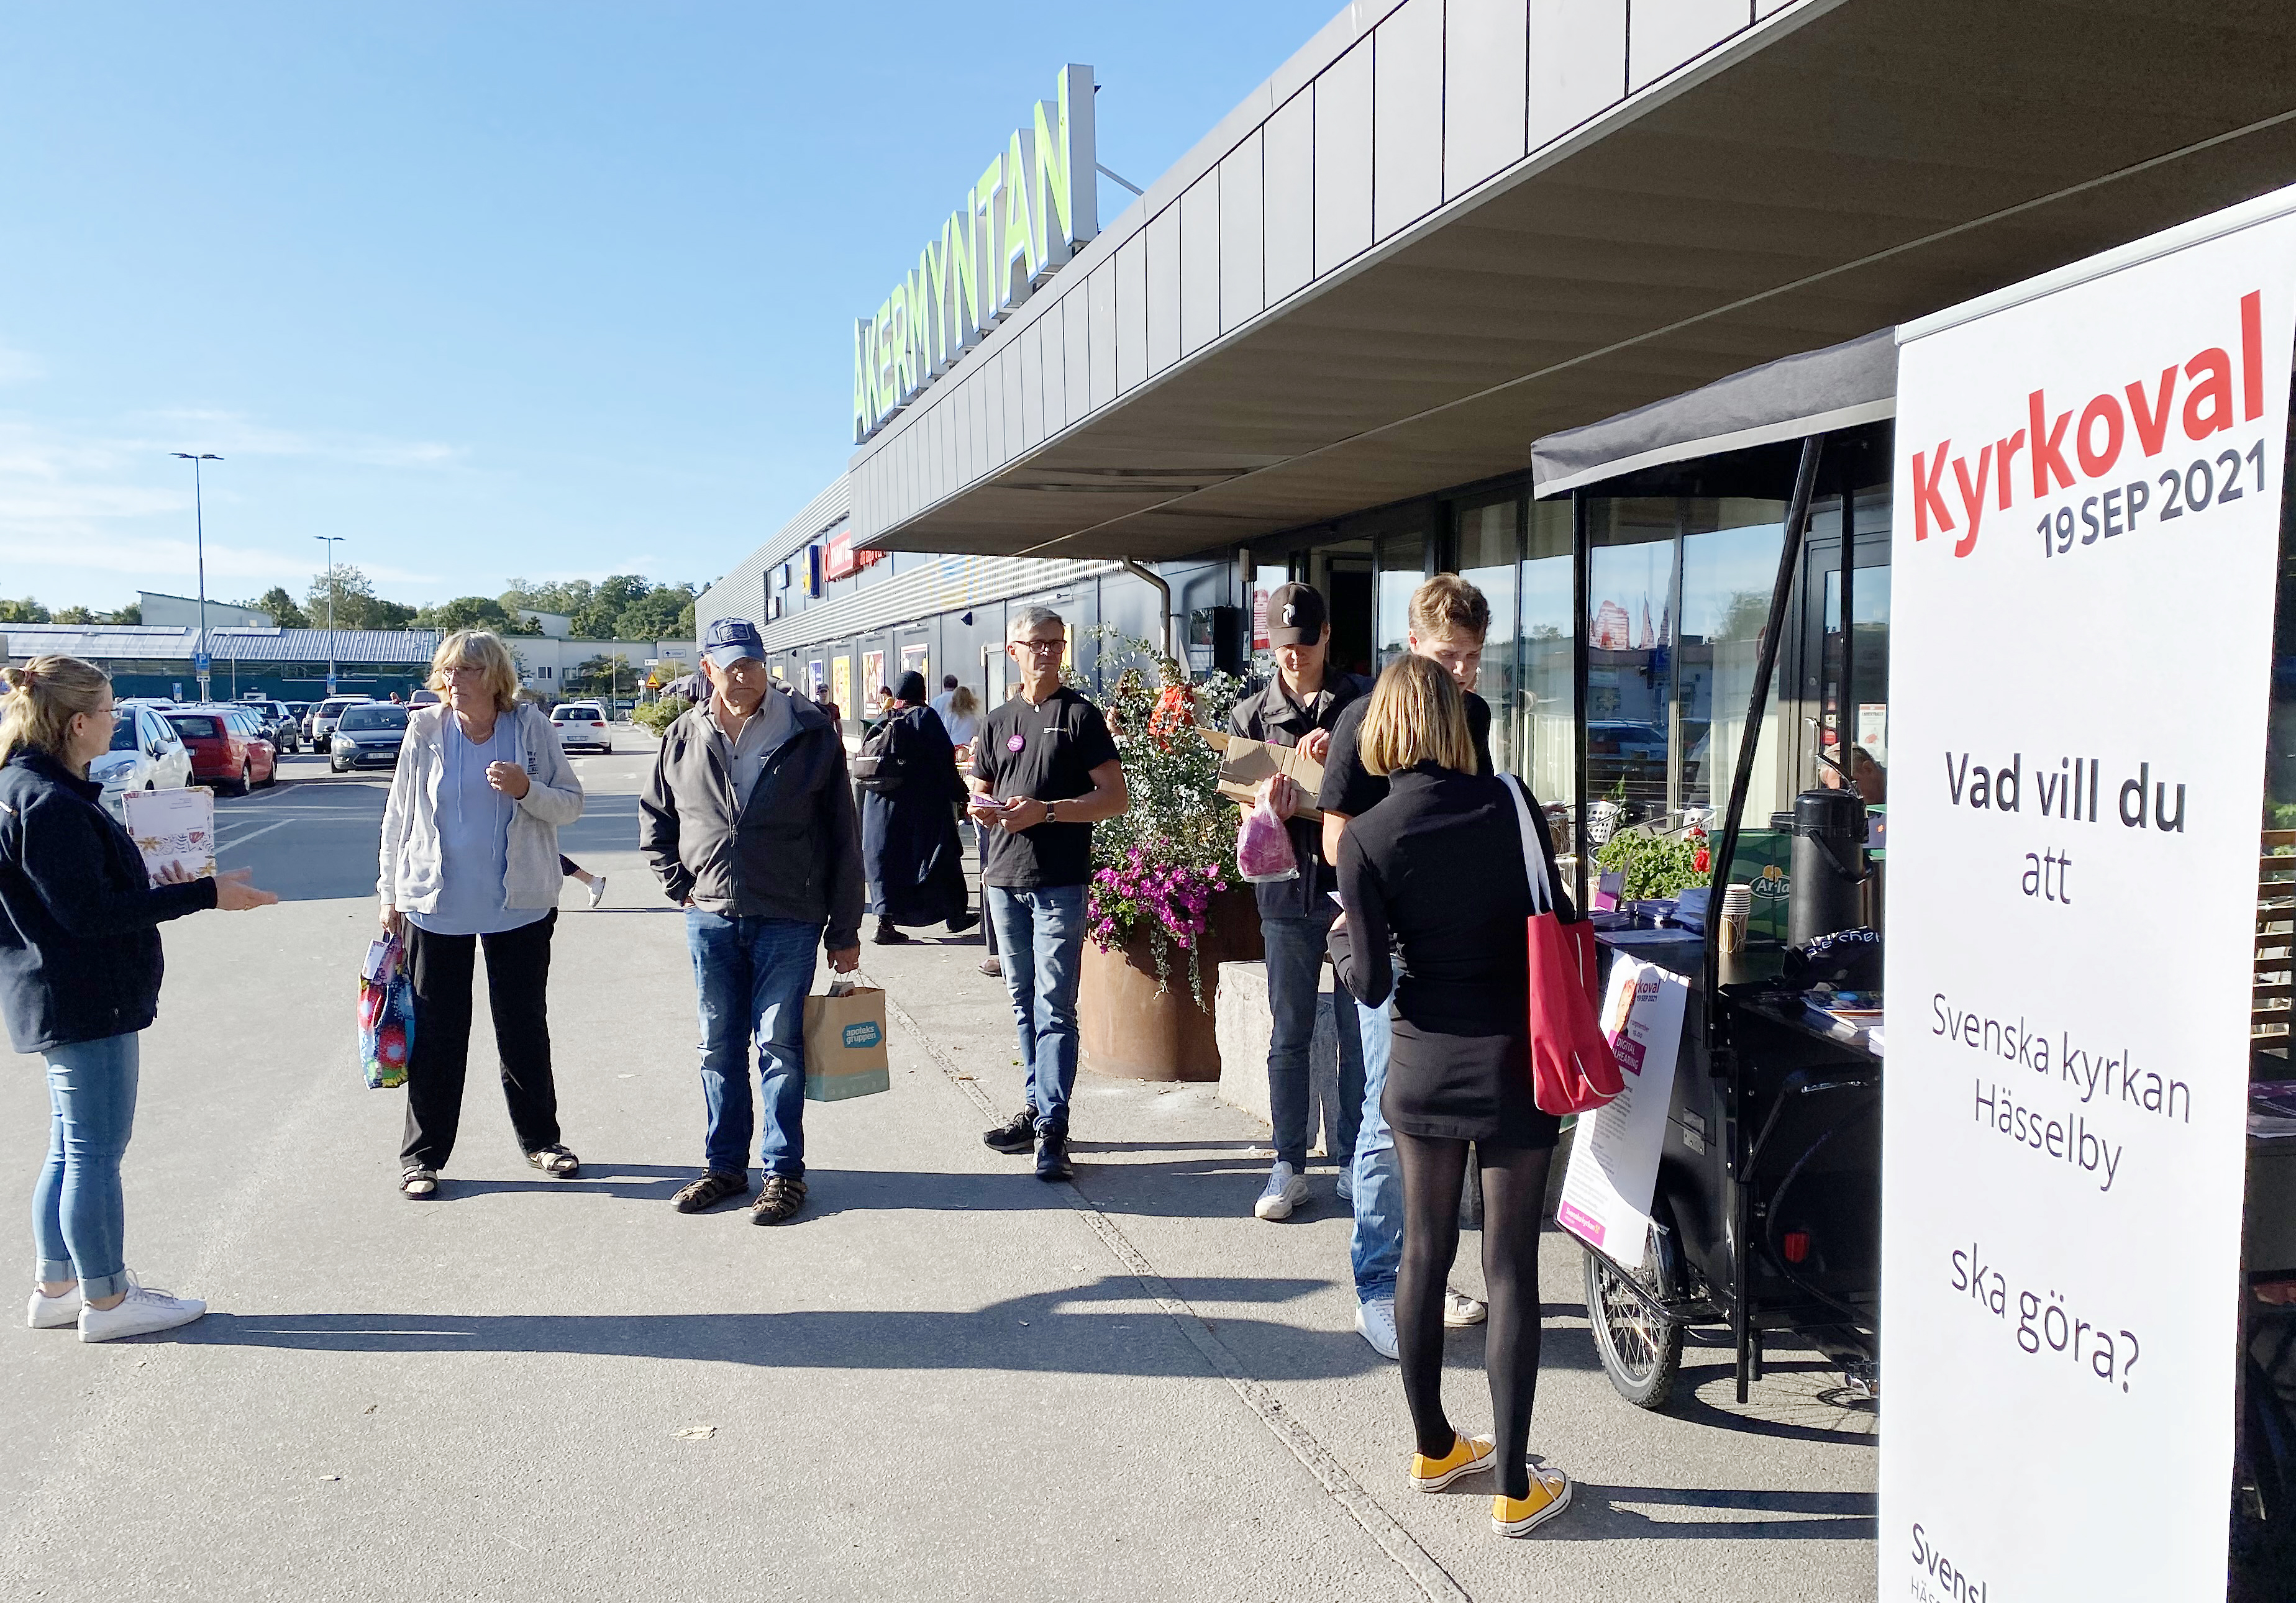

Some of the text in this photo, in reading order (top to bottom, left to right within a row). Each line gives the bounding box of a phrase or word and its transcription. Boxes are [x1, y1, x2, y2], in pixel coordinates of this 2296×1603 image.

[854, 63, 1076, 445] ÅKERMYNTAN
[1912, 289, 2265, 558] Kyrkoval
[2036, 437, 2266, 558] 19 SEP 2021
[1945, 752, 2187, 833] Vad vill du
[1756, 879, 1790, 894] Arla
[2021, 846, 2072, 905] att
[845, 1032, 877, 1045] gruppen
[846, 1025, 875, 1037] apoteks
[1616, 1037, 1636, 1055] DIGITAL
[1932, 992, 2192, 1124] Svenska kyrkan
[1975, 1078, 2123, 1192] Hässelby
[1951, 1242, 2140, 1393] ska göra?
